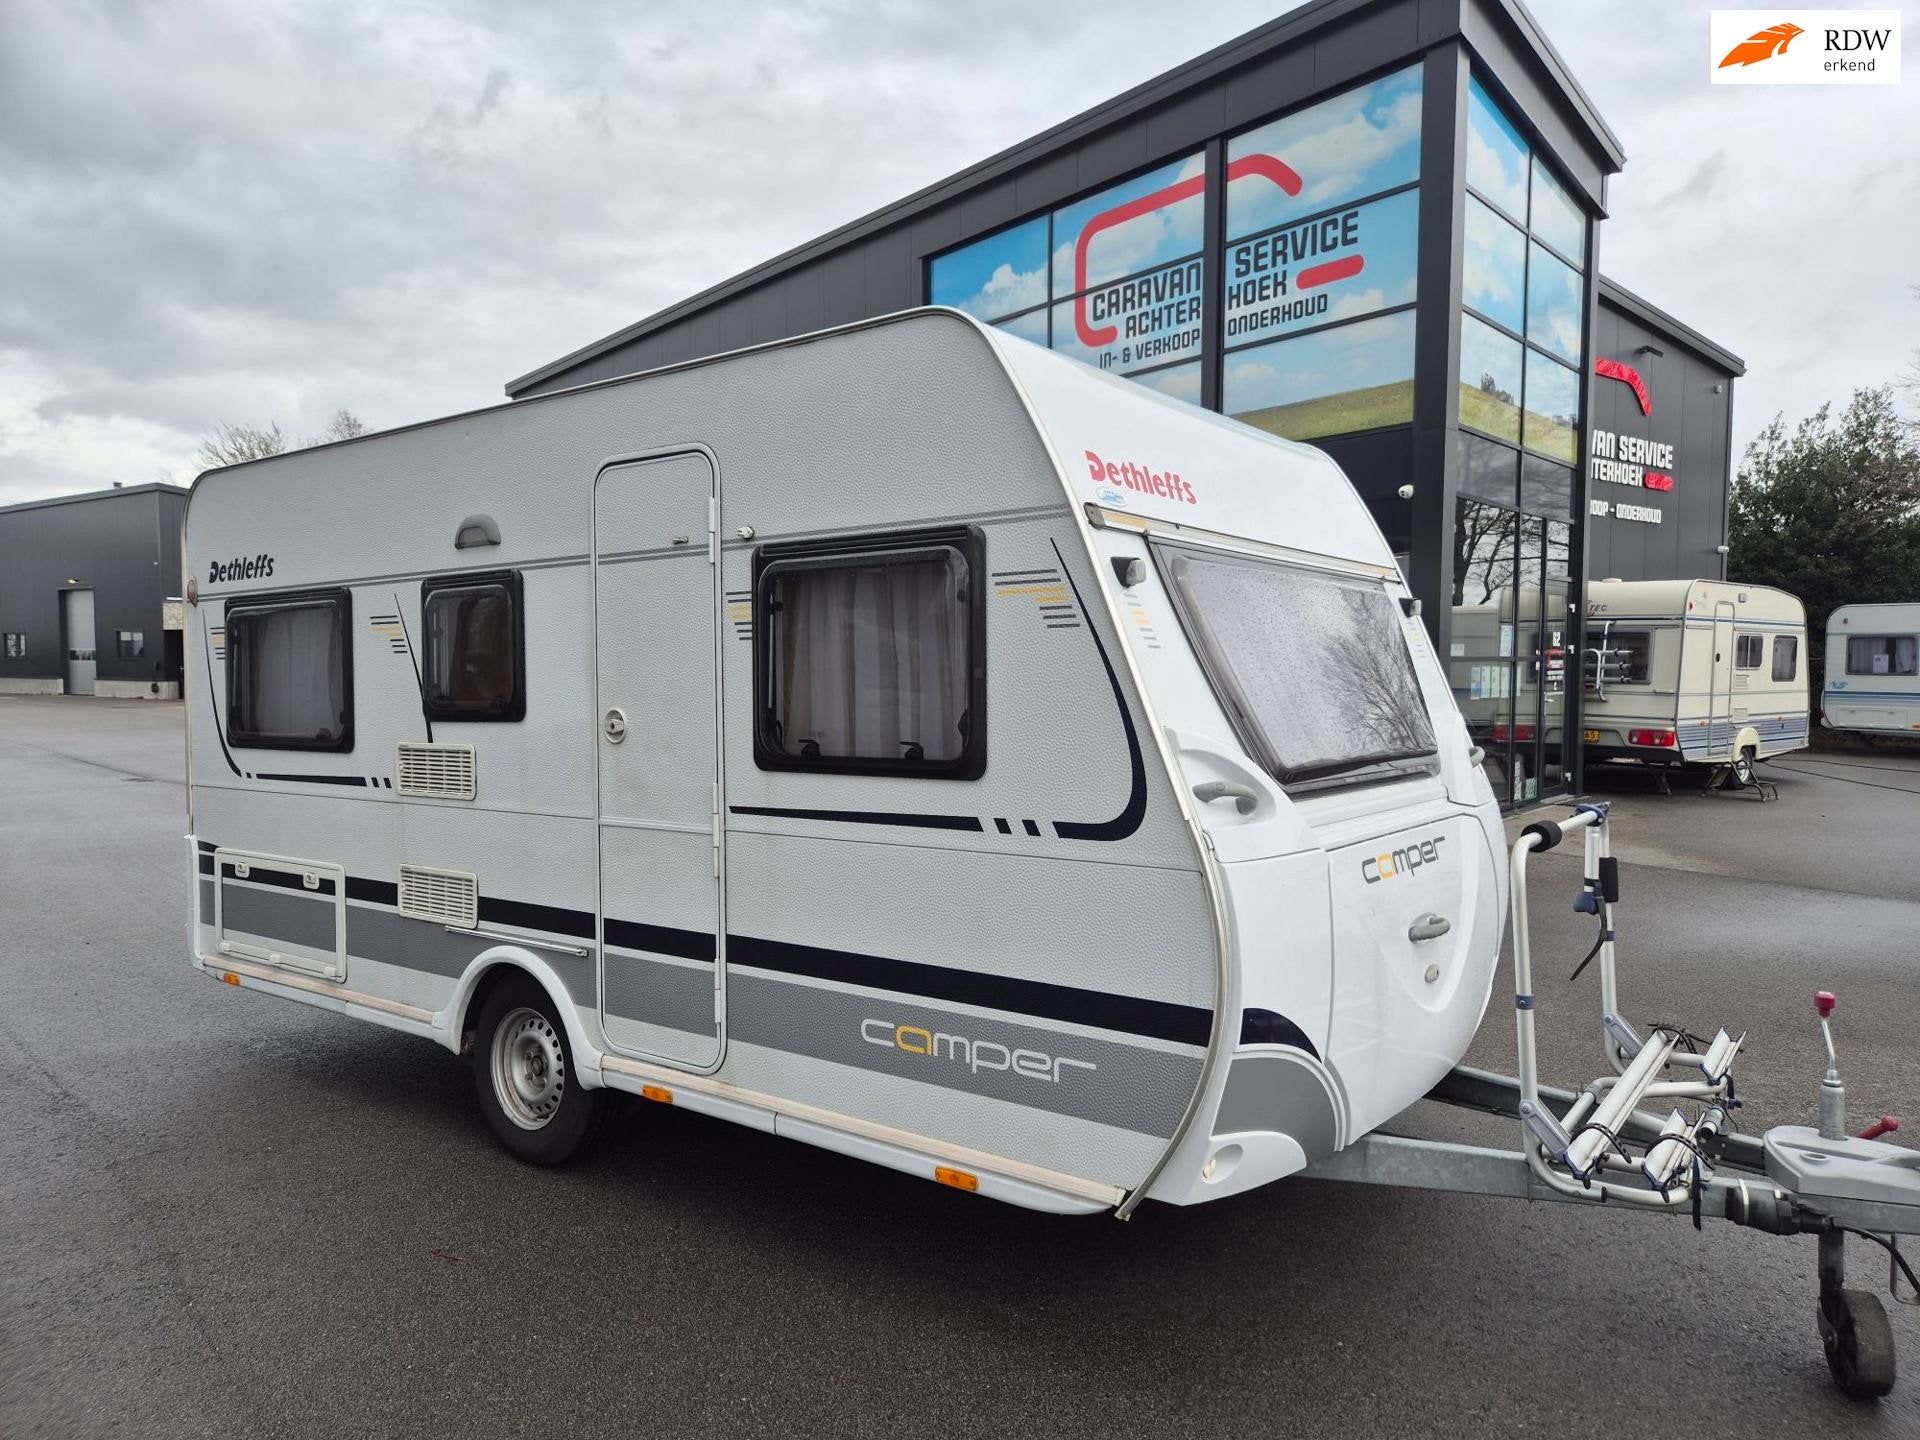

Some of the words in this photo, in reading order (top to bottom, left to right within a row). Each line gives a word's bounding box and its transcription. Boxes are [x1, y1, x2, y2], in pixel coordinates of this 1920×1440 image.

[1092, 262, 1201, 322] CARAVAN
[1235, 210, 1359, 278] SERVICE
[1125, 296, 1201, 340] ACHTER
[1228, 269, 1287, 310] HOEK
[1100, 351, 1118, 369] IN-
[1122, 346, 1132, 364] &
[1136, 328, 1200, 361] VERKOOP
[1227, 293, 1328, 336] ONDERHOUD
[1085, 449, 1197, 505] Dethleffs
[1591, 457, 1643, 487] TERHOEK
[1619, 435, 1674, 470] SERVICE
[1615, 503, 1662, 524] ONDERHOUD
[209, 554, 274, 583] Dethleffs
[1361, 836, 1446, 884] camper
[860, 1018, 1097, 1083] camper
